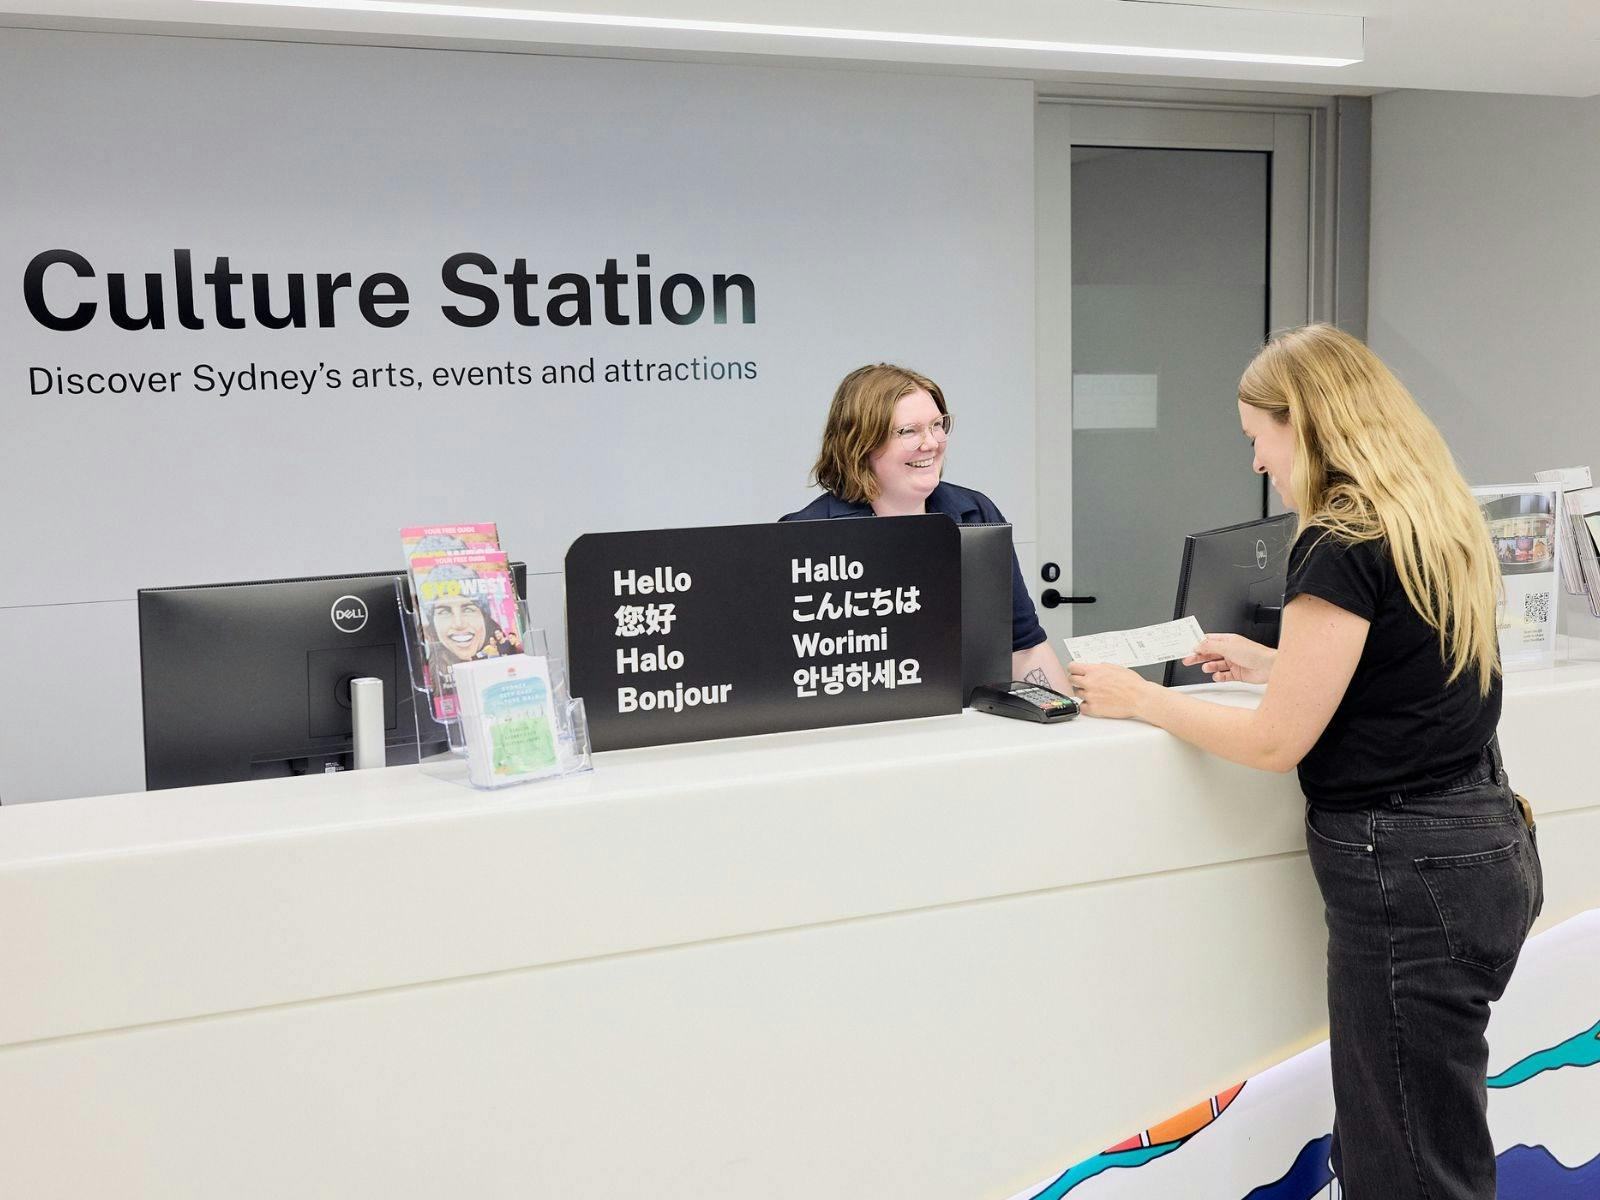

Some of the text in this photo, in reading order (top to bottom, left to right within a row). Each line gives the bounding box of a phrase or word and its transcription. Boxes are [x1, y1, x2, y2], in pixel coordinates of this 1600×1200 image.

[23, 248, 757, 332] Culture Station
[29, 355, 757, 398] Discover Sydney’s arts, events and attractions
[434, 557, 452, 565] YOUR
[791, 554, 864, 584] Hallo
[613, 566, 692, 597] Hello
[335, 608, 365, 620] DELL
[613, 602, 677, 637] 您好
[792, 585, 922, 623] こんにちは
[791, 626, 888, 658] Worimi
[616, 644, 685, 675] Halo
[792, 658, 922, 698] 안녕하세요
[617, 681, 733, 714] Bonjour
